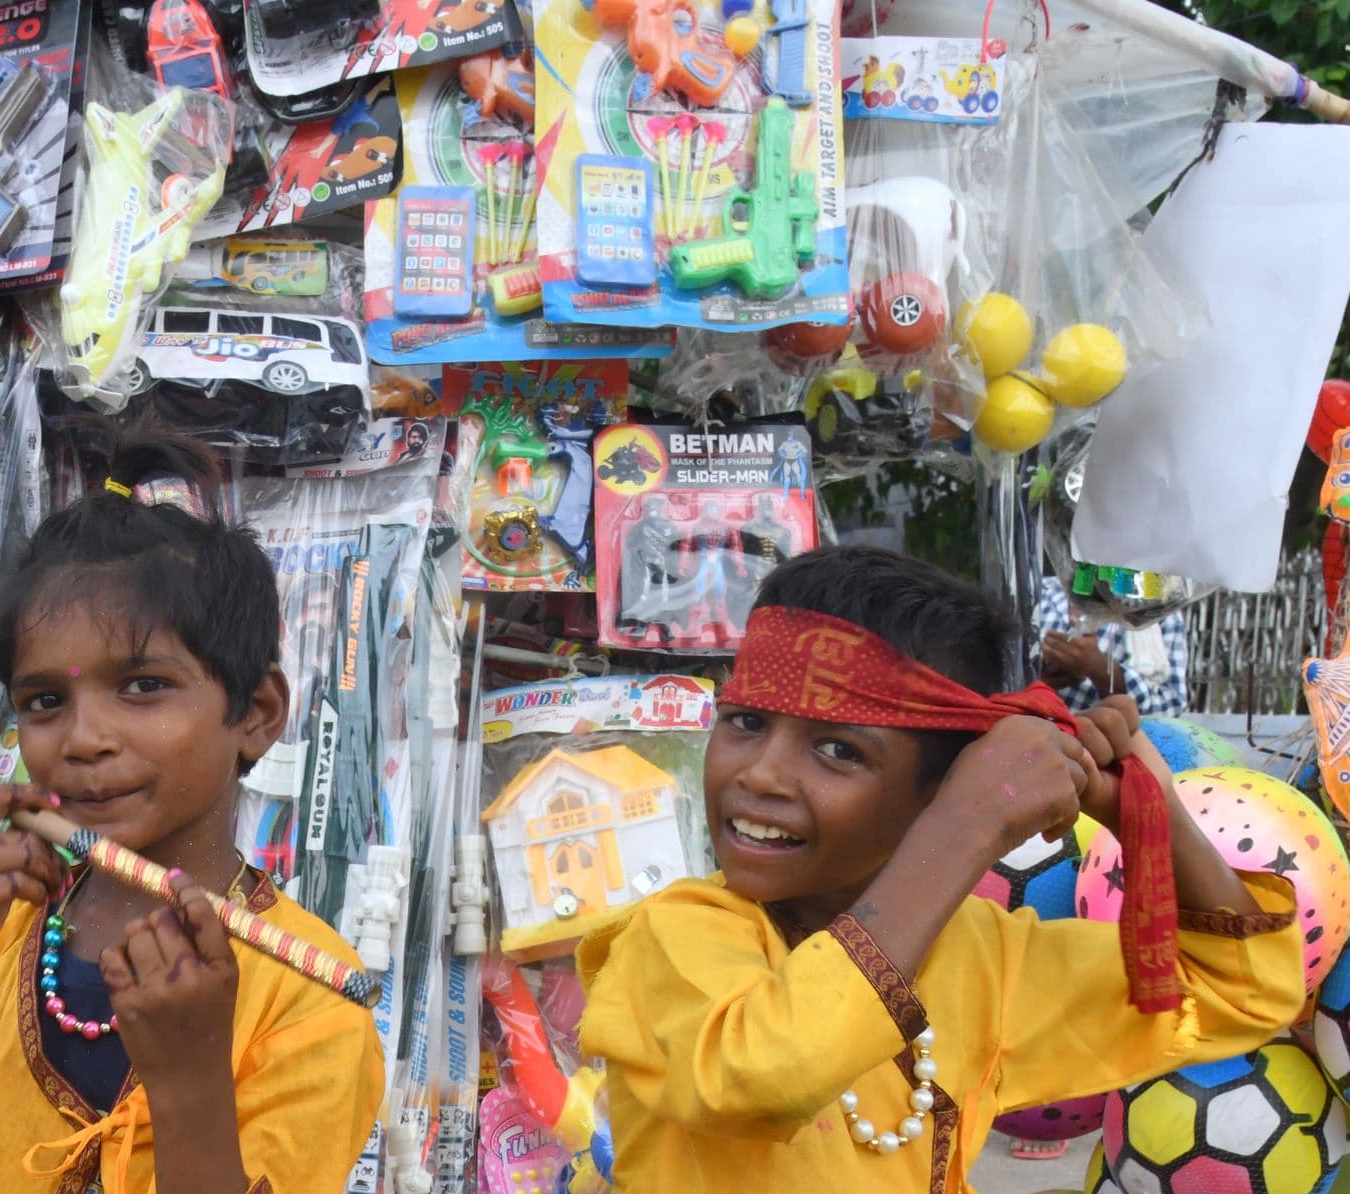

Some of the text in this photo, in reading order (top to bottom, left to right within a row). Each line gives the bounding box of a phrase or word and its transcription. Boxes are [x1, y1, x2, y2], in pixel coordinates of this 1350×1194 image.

[443, 37, 465, 46] Item
[816, 22, 837, 218] AIM TARGET AND SHOOT
[336, 184, 358, 196] Item
[197, 337, 260, 358] Jio
[670, 433, 775, 454] BETMAN
[671, 457, 695, 466] MASK
[677, 470, 769, 484] SLIDER-MAN
[344, 577, 367, 674] ROCKY GUN
[495, 689, 578, 715] WONDER
[313, 720, 335, 789] ROYAL
[376, 1018, 390, 1035] &
[448, 1008, 466, 1025] &
[448, 1026, 467, 1084] SHOOT
